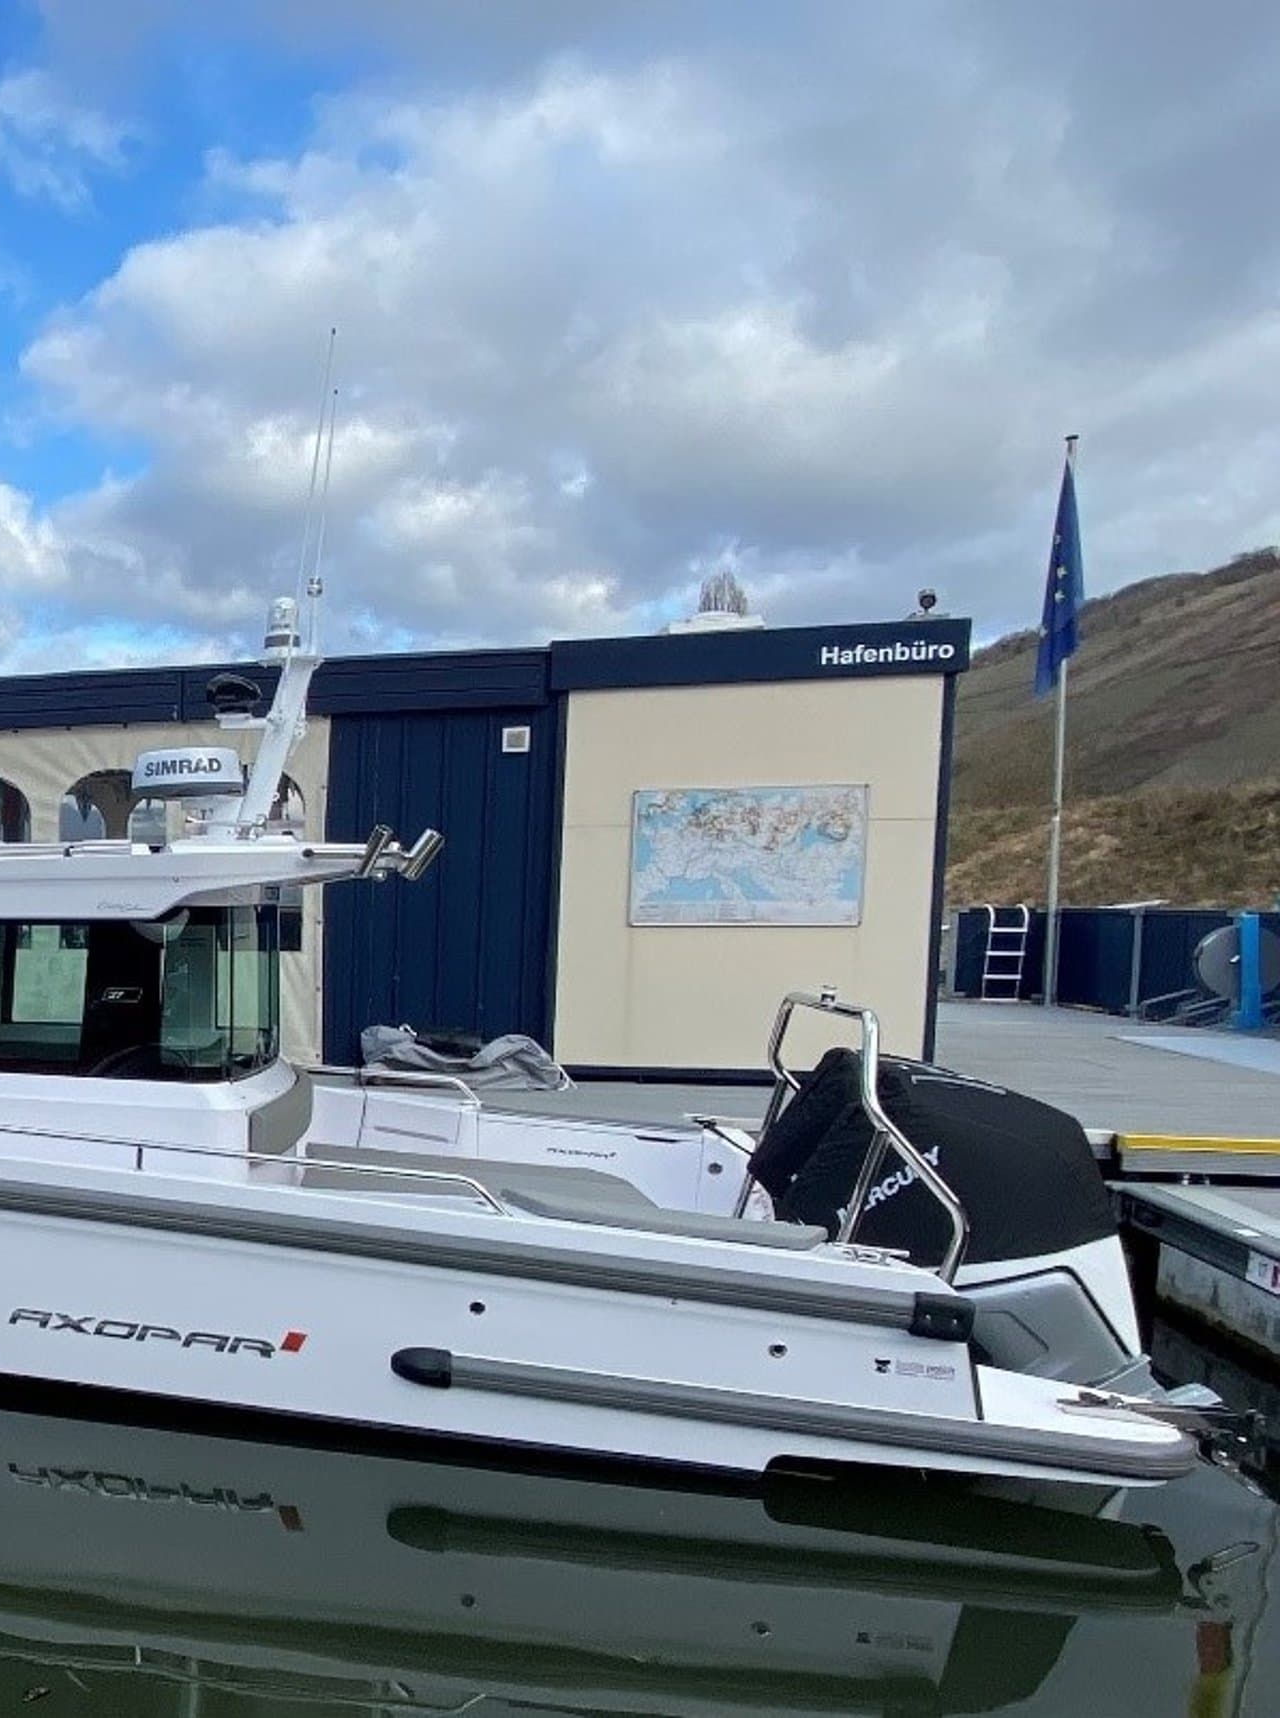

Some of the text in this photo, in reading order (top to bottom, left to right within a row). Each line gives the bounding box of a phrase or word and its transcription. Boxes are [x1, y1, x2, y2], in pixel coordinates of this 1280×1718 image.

[821, 640, 955, 665] Hafenbüro
[144, 758, 222, 777] SIMRAD
[8, 1308, 276, 1358] AXOPAR
